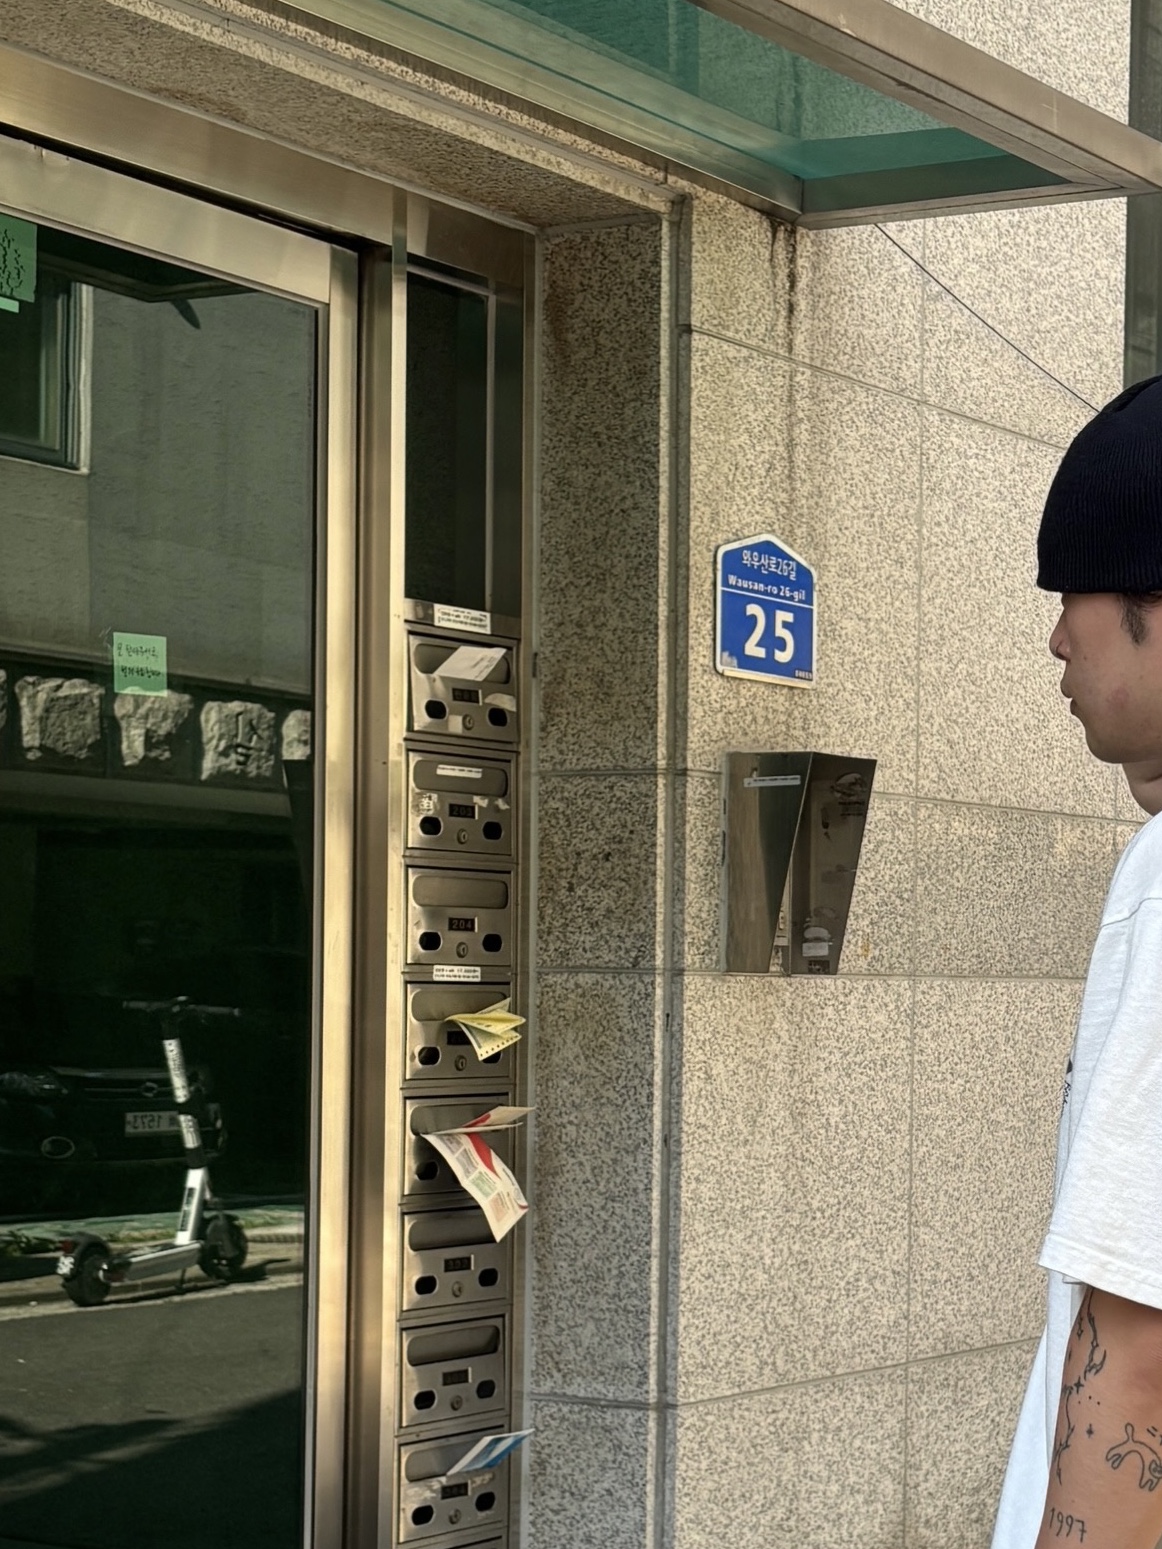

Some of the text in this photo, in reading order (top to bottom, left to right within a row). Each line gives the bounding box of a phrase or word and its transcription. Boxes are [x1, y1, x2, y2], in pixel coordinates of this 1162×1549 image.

[742, 549, 797, 581] 와우산로26길
[728, 574, 806, 602] Wausan-ro 26-gil
[744, 603, 795, 663] 25
[452, 919, 473, 930] 204
[1049, 1507, 1088, 1543] 1997
